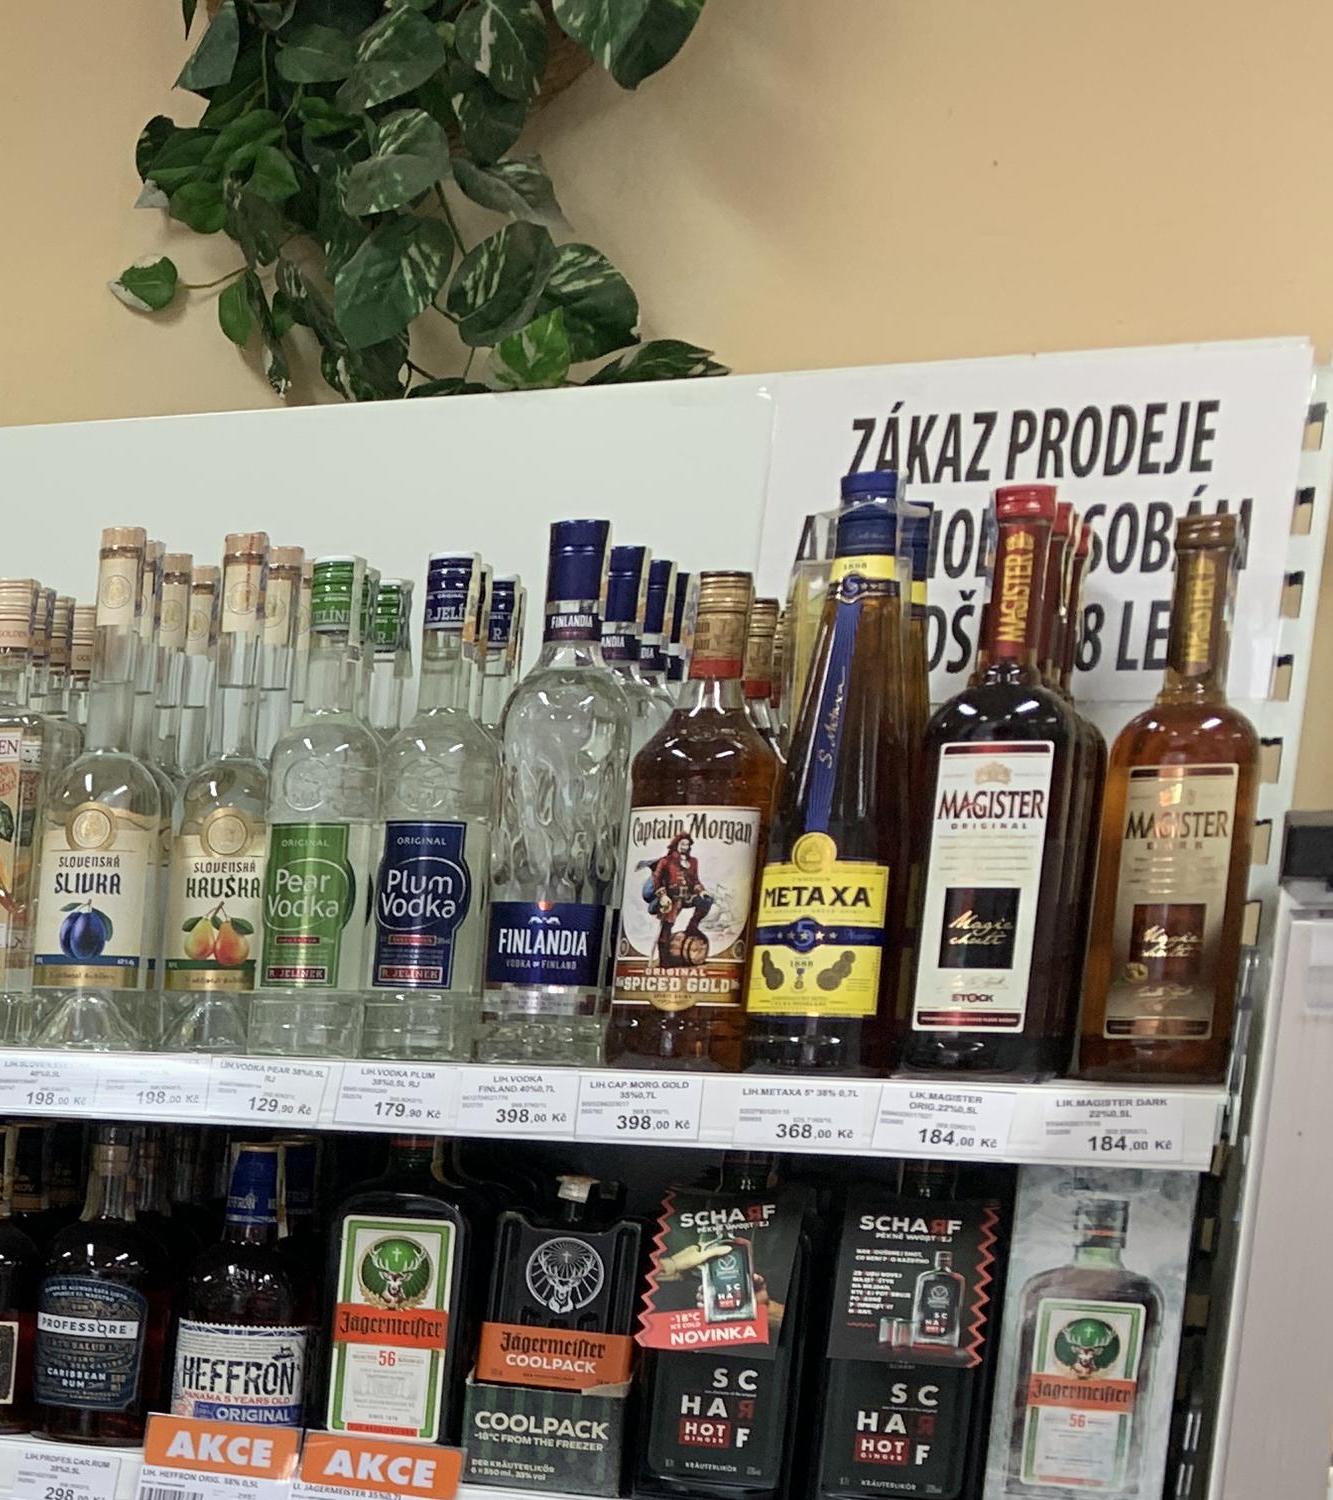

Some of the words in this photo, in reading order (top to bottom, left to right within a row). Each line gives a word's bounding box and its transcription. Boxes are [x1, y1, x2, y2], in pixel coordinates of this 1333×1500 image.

[848, 402, 998, 484] ZÁKAZ
[1005, 400, 1221, 480] PRODEJE
[550, 612, 593, 629] FINLANDIA
[937, 789, 1045, 820] MAGISTER
[632, 814, 683, 847] Captain
[687, 813, 752, 842] Morgan
[951, 822, 1028, 830] ORIGINAL
[1126, 810, 1229, 840] MAGISTER
[54, 872, 122, 896] SLIVKA
[274, 868, 333, 896] Pear
[386, 869, 454, 897] Plum
[267, 895, 340, 920] Vodka
[380, 893, 457, 920] Vodka
[764, 886, 872, 908] METAXA
[498, 927, 589, 958] FINLANDIA
[623, 976, 683, 993] SPICED
[686, 977, 730, 993] GOLD
[669, 1324, 757, 1345] NOVINKA
[379, 1350, 396, 1367] 56
[506, 1354, 596, 1374] COOLPACK
[181, 1354, 295, 1395] HEFFRON
[216, 1406, 290, 1423] ORIGINAL
[474, 1411, 610, 1442] COOLPACK
[502, 1433, 531, 1446] FROM
[553, 1439, 604, 1452] FREEZER
[684, 1422, 726, 1440] HOT
[165, 1430, 274, 1468] AKCE
[323, 1449, 437, 1488] AKCE
